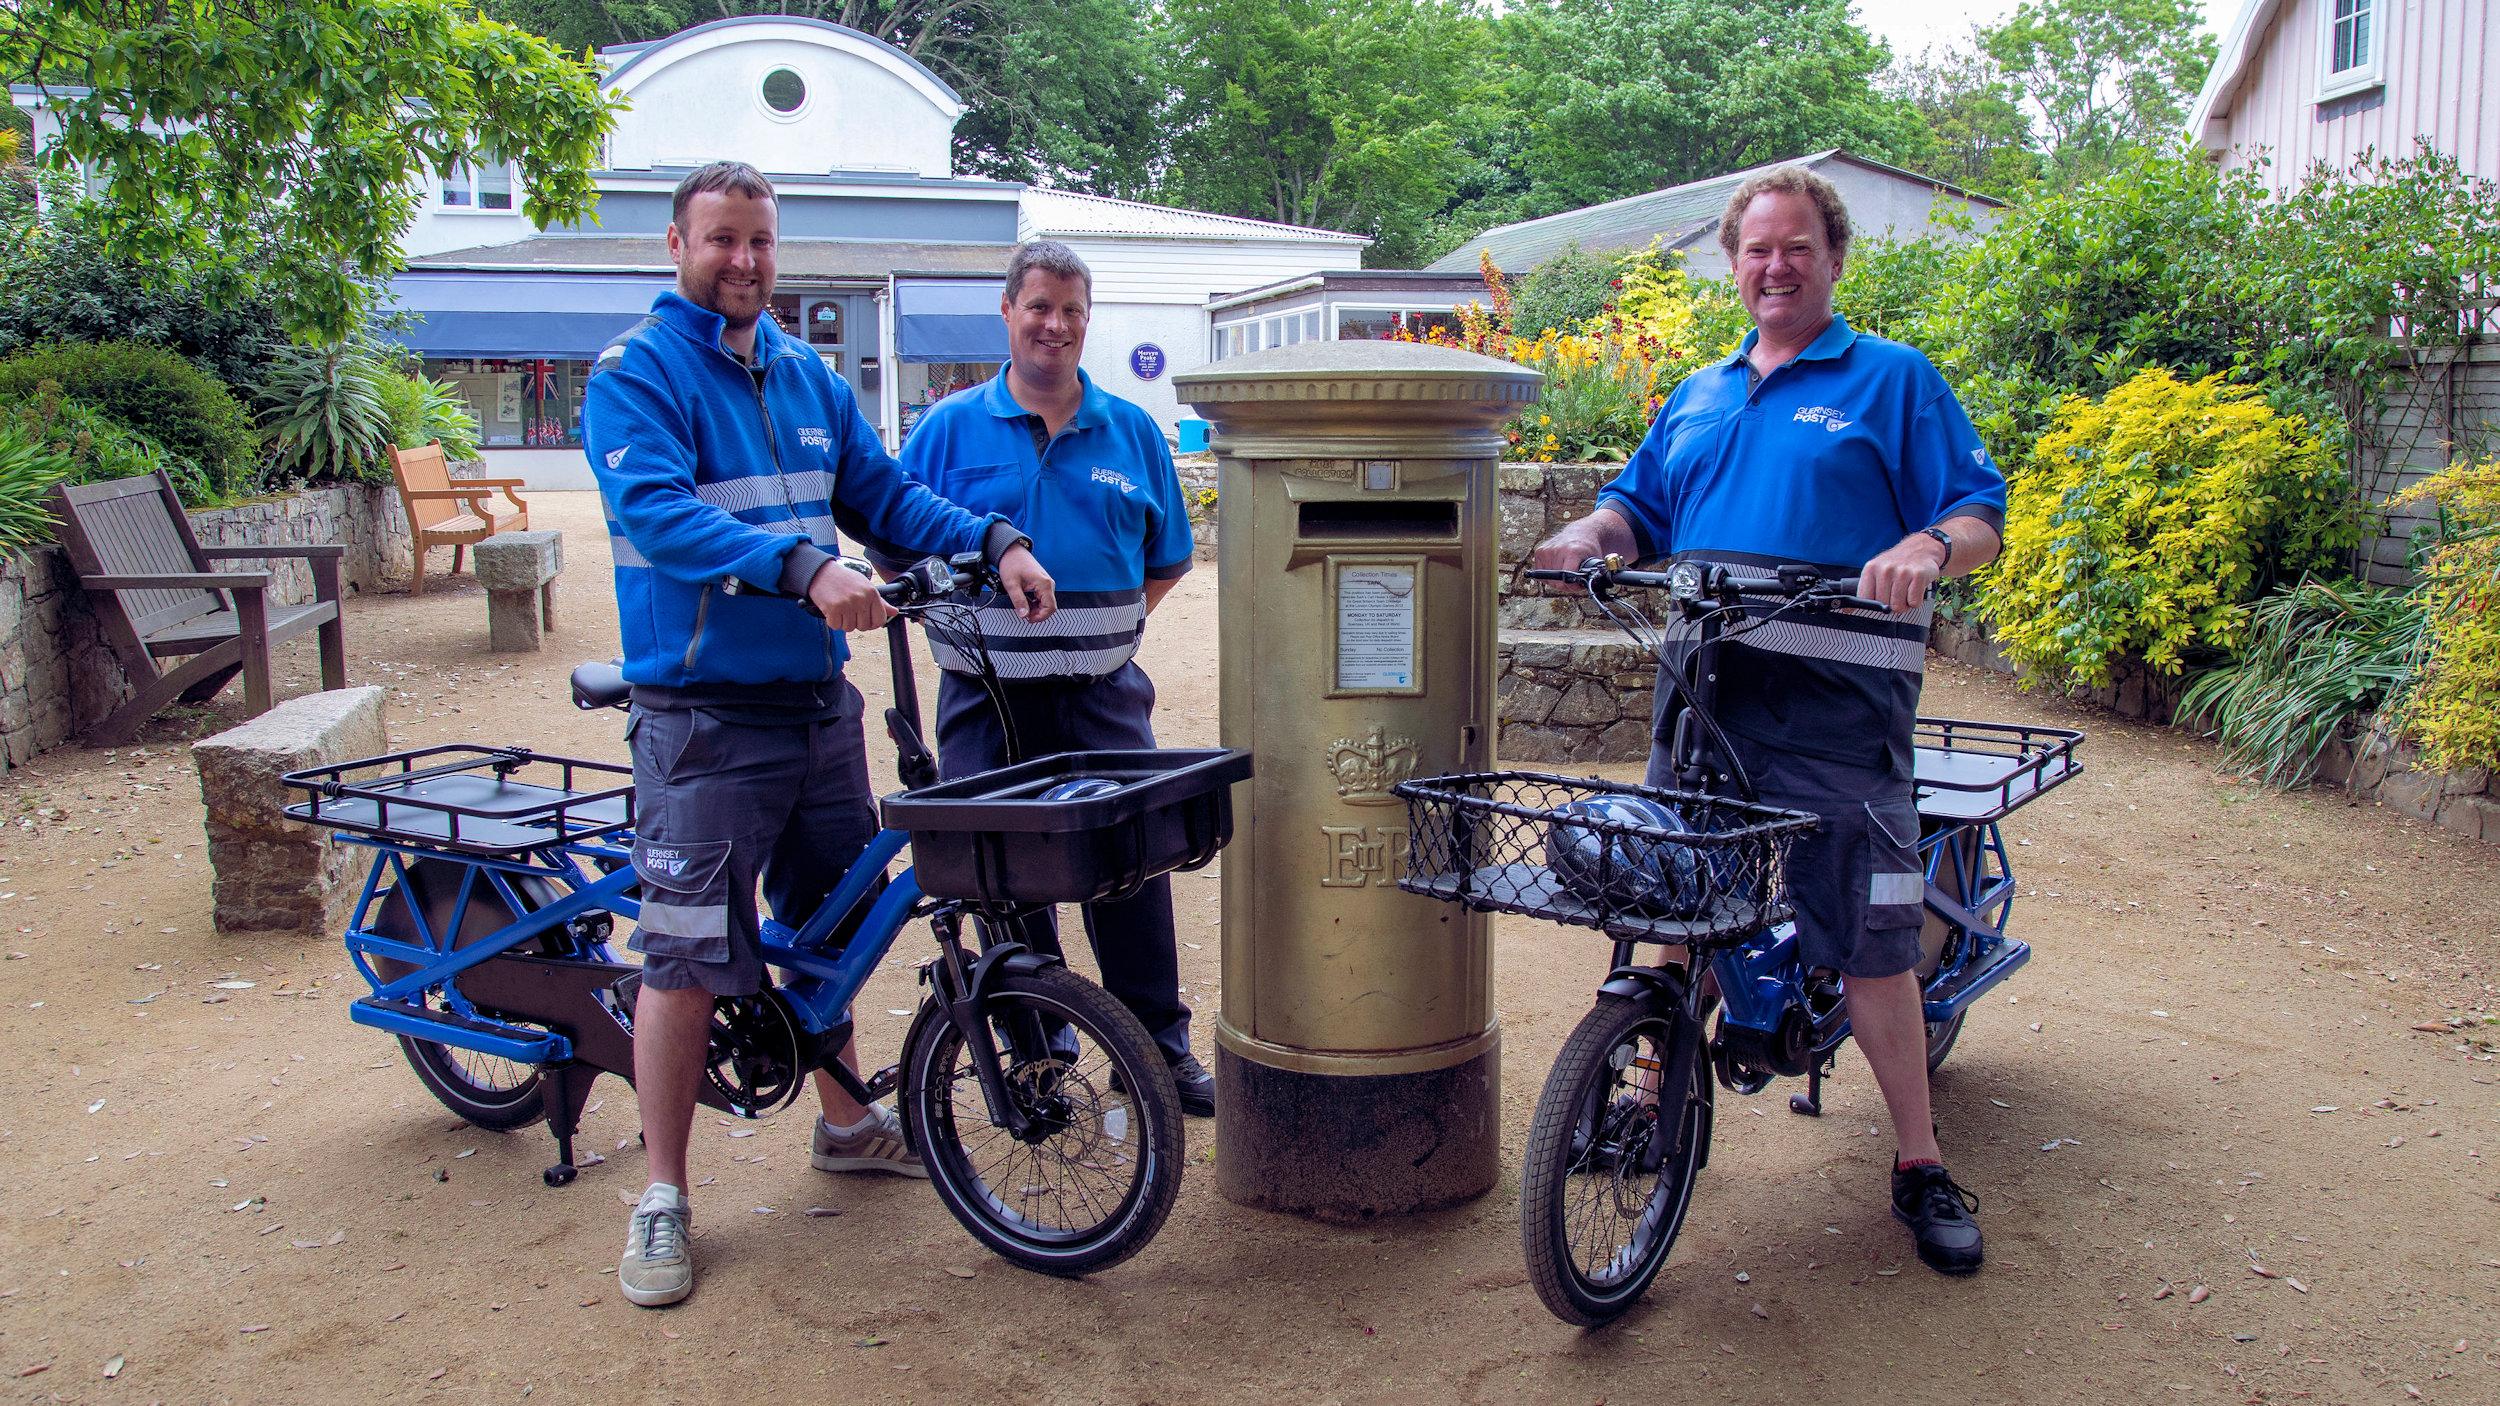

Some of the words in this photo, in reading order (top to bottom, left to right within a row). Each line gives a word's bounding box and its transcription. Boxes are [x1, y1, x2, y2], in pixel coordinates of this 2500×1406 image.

[1792, 412, 1828, 424] POST
[1797, 406, 1846, 419] GUERNSEY
[800, 436, 824, 447] POST
[1091, 466, 1130, 483] GUERNSEY
[1091, 473, 1121, 486] POST
[1296, 468, 1353, 479] COLLECTION
[646, 848, 680, 859] GUERNSEY
[646, 857, 668, 870] POST
